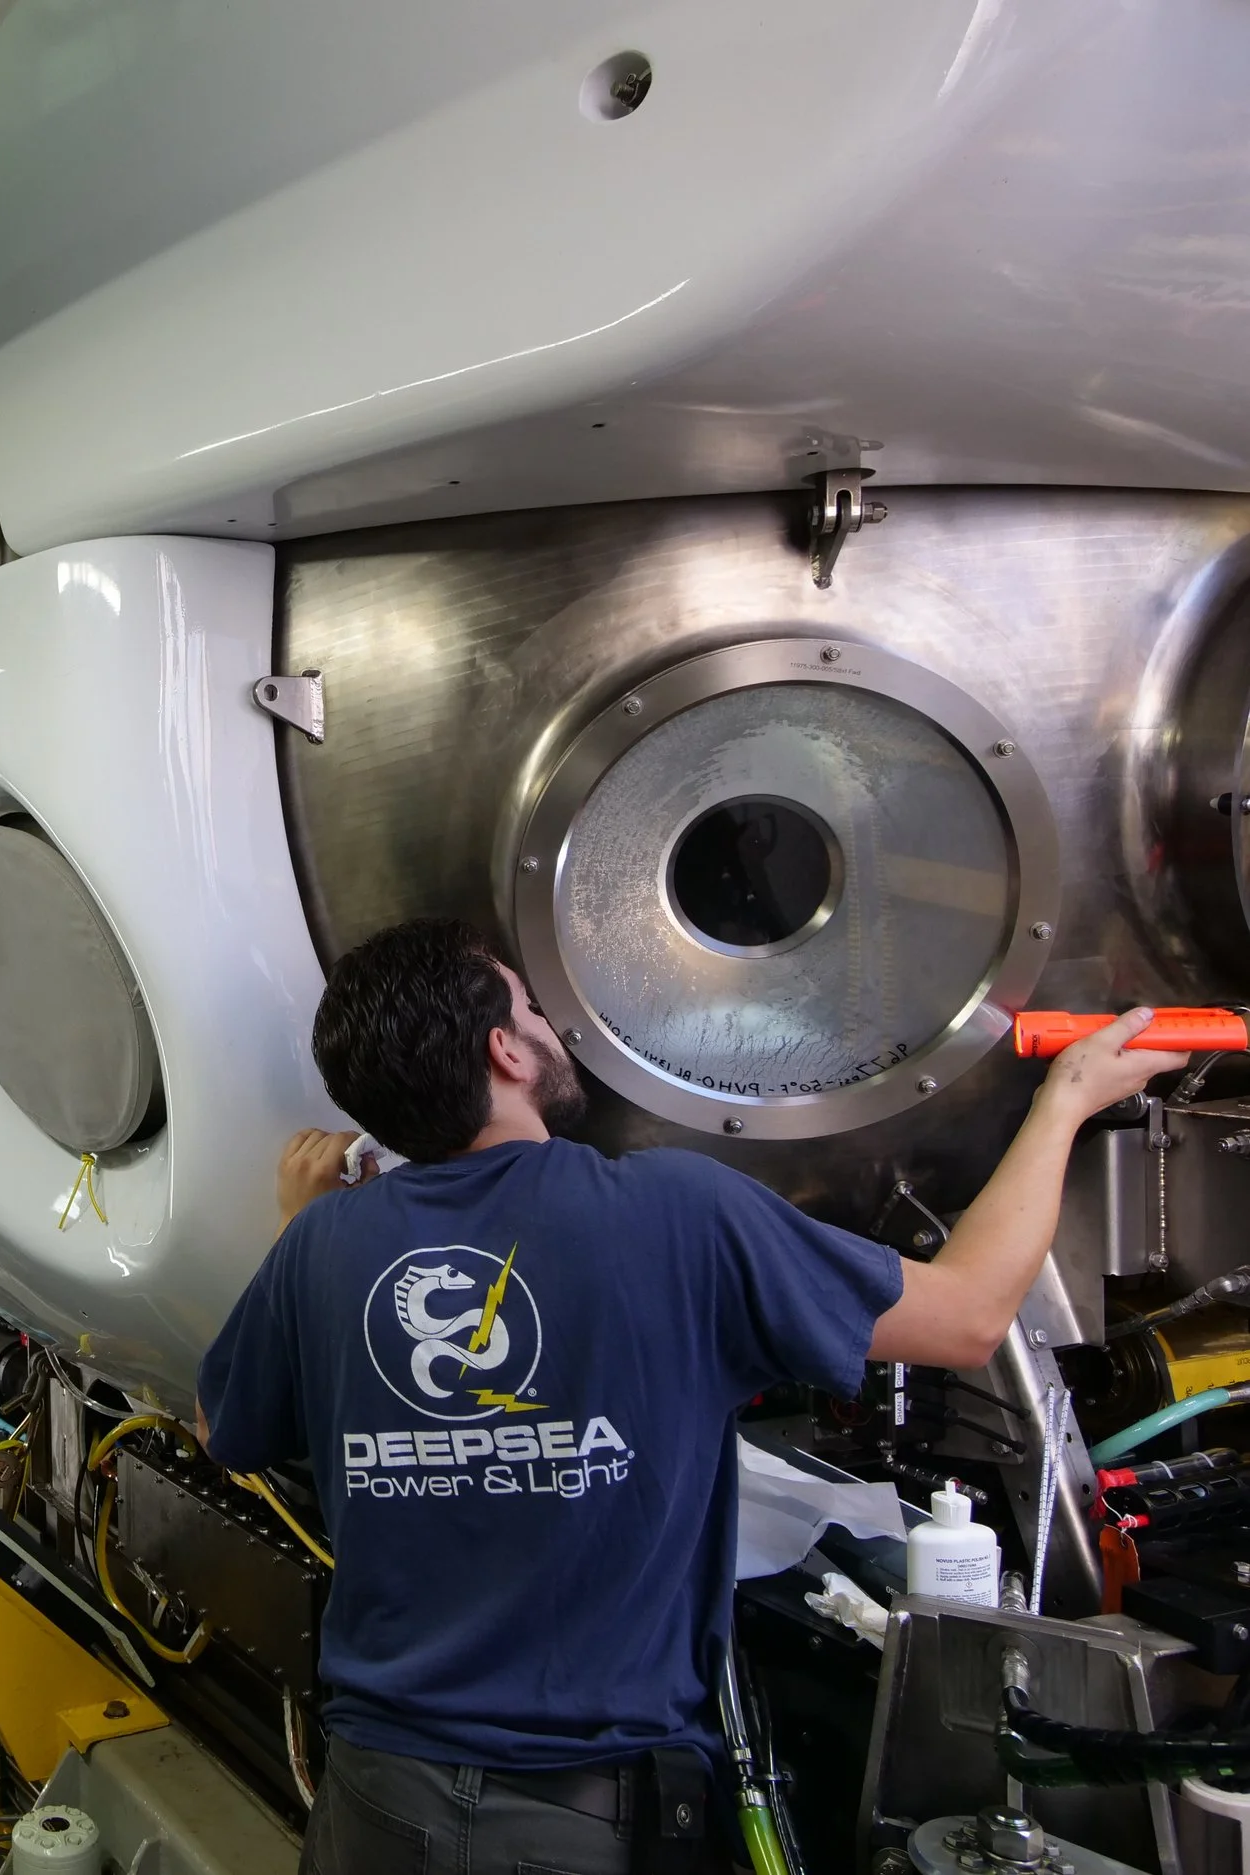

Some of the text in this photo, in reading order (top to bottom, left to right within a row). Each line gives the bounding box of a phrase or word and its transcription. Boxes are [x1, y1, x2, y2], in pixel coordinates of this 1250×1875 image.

[343, 1415, 628, 1468] DEEPSEA
[345, 1470, 474, 1498] Power
[483, 1465, 523, 1495] &
